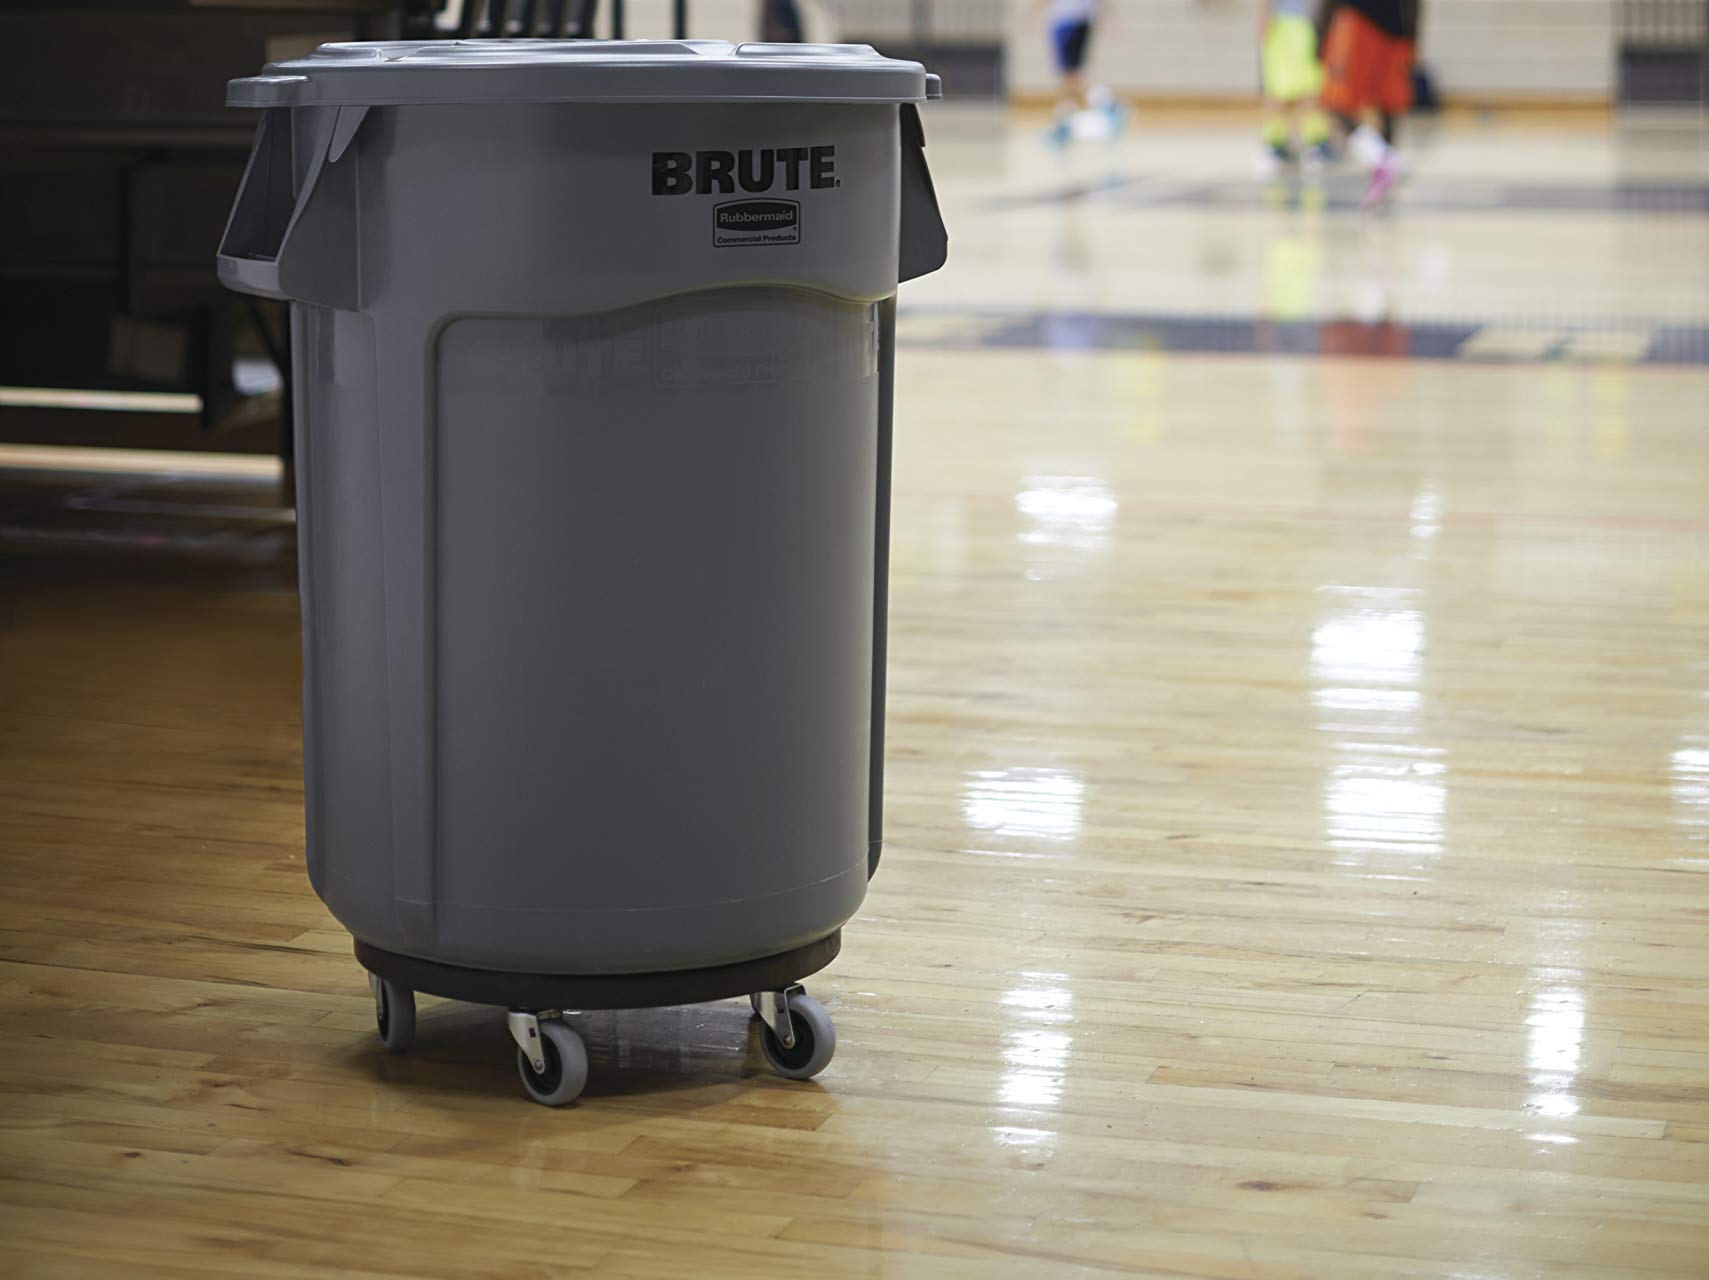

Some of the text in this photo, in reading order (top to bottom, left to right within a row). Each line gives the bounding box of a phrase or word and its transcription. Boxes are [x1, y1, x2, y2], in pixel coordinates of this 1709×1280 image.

[651, 145, 835, 196] BRUTE
[720, 210, 794, 224] Rubbermaid
[717, 233, 796, 244] Commercial Products
